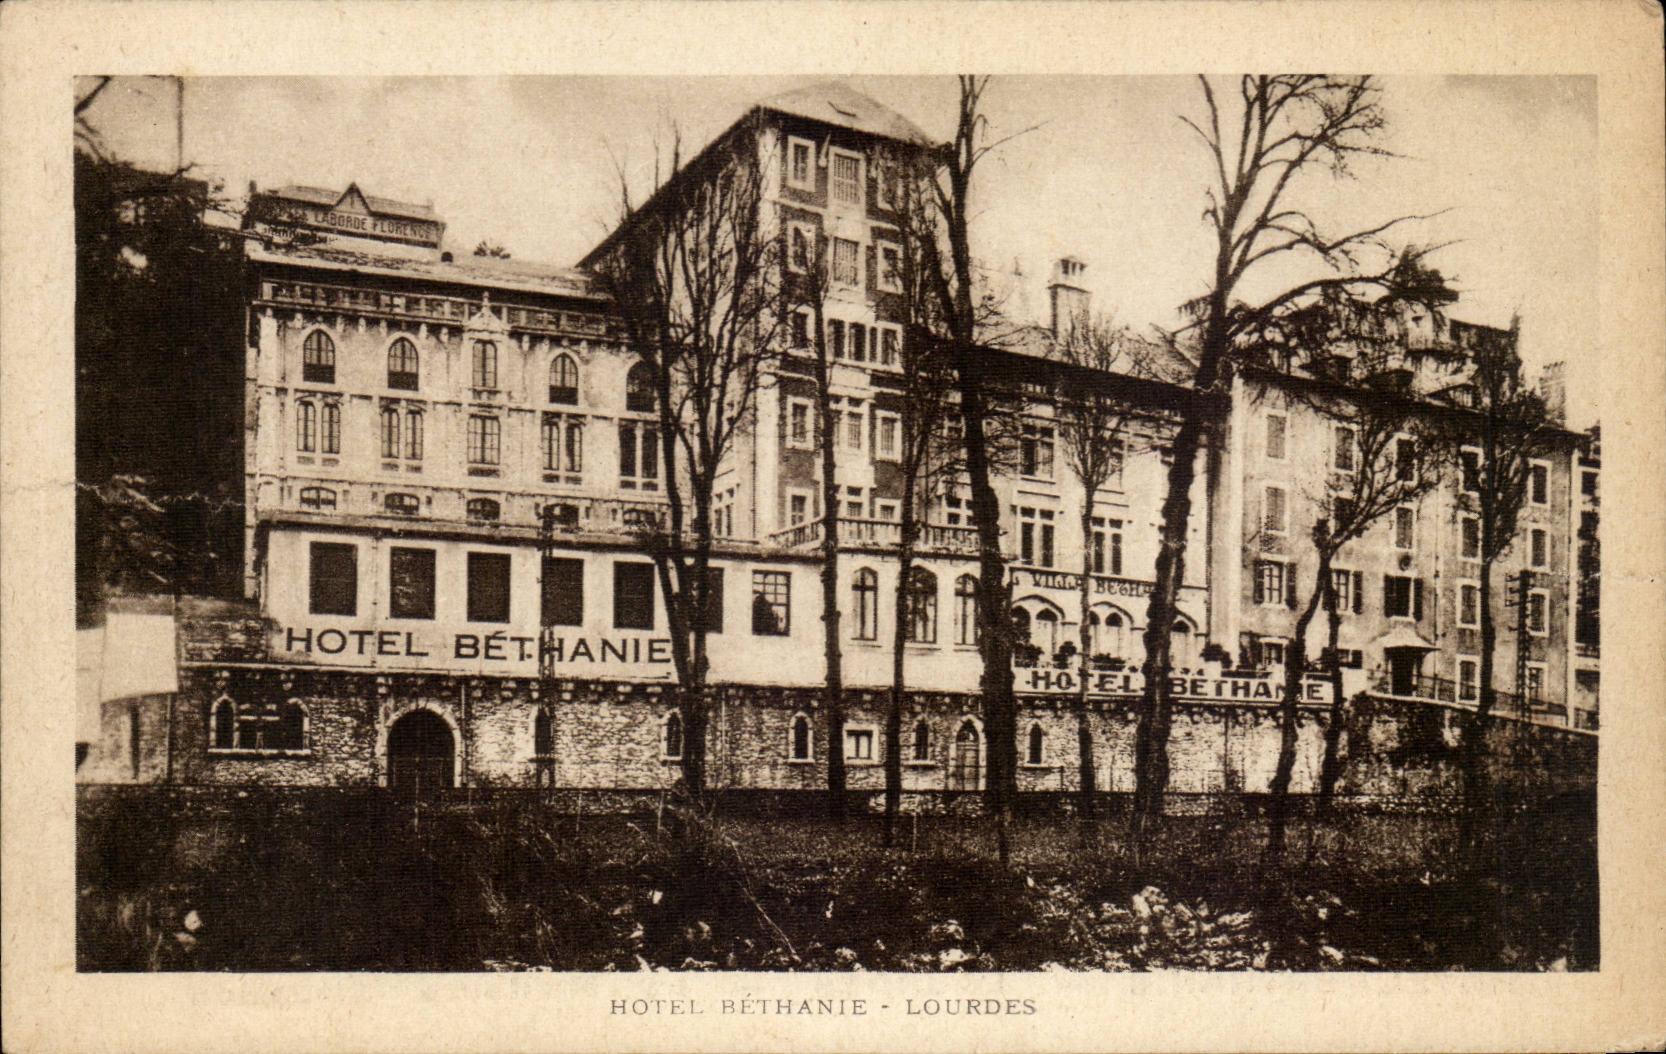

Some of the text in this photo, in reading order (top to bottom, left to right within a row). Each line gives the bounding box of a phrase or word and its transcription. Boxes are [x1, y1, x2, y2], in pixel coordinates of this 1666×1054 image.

[314, 210, 367, 231] LABORDE
[286, 627, 429, 657] HOTEL
[1168, 677, 1325, 701] BETHANE
